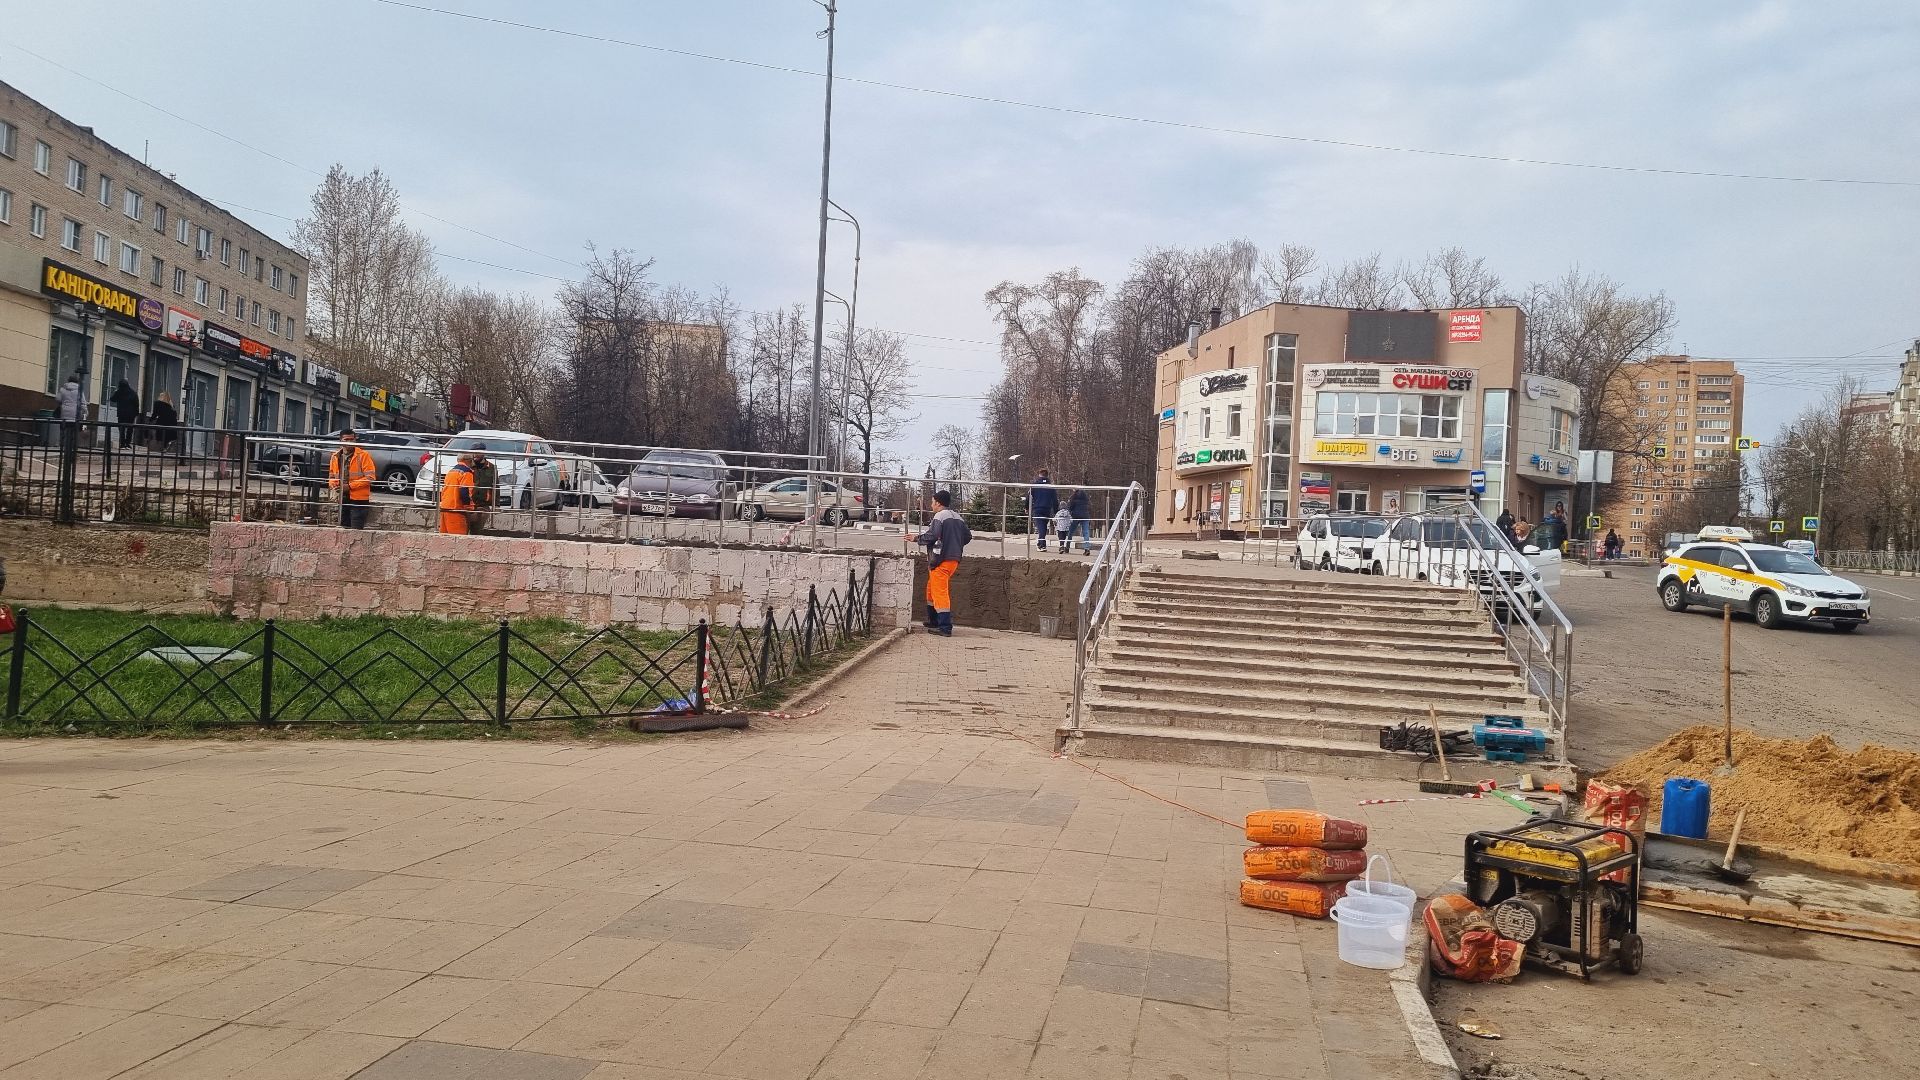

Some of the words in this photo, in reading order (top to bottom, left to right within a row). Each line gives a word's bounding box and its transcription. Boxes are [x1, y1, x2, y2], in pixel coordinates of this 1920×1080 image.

[46, 265, 137, 317] КАНЦТОВАРЫ
[1452, 315, 1480, 323] АРЕНДА
[1213, 449, 1248, 463] ОКНА
[1391, 448, 1418, 461] ВТБ
[1433, 449, 1455, 458] БАНК
[1539, 459, 1553, 471] ВТБ
[1686, 577, 1703, 594] Go
[1272, 823, 1297, 834] 500
[1275, 859, 1302, 871] 500
